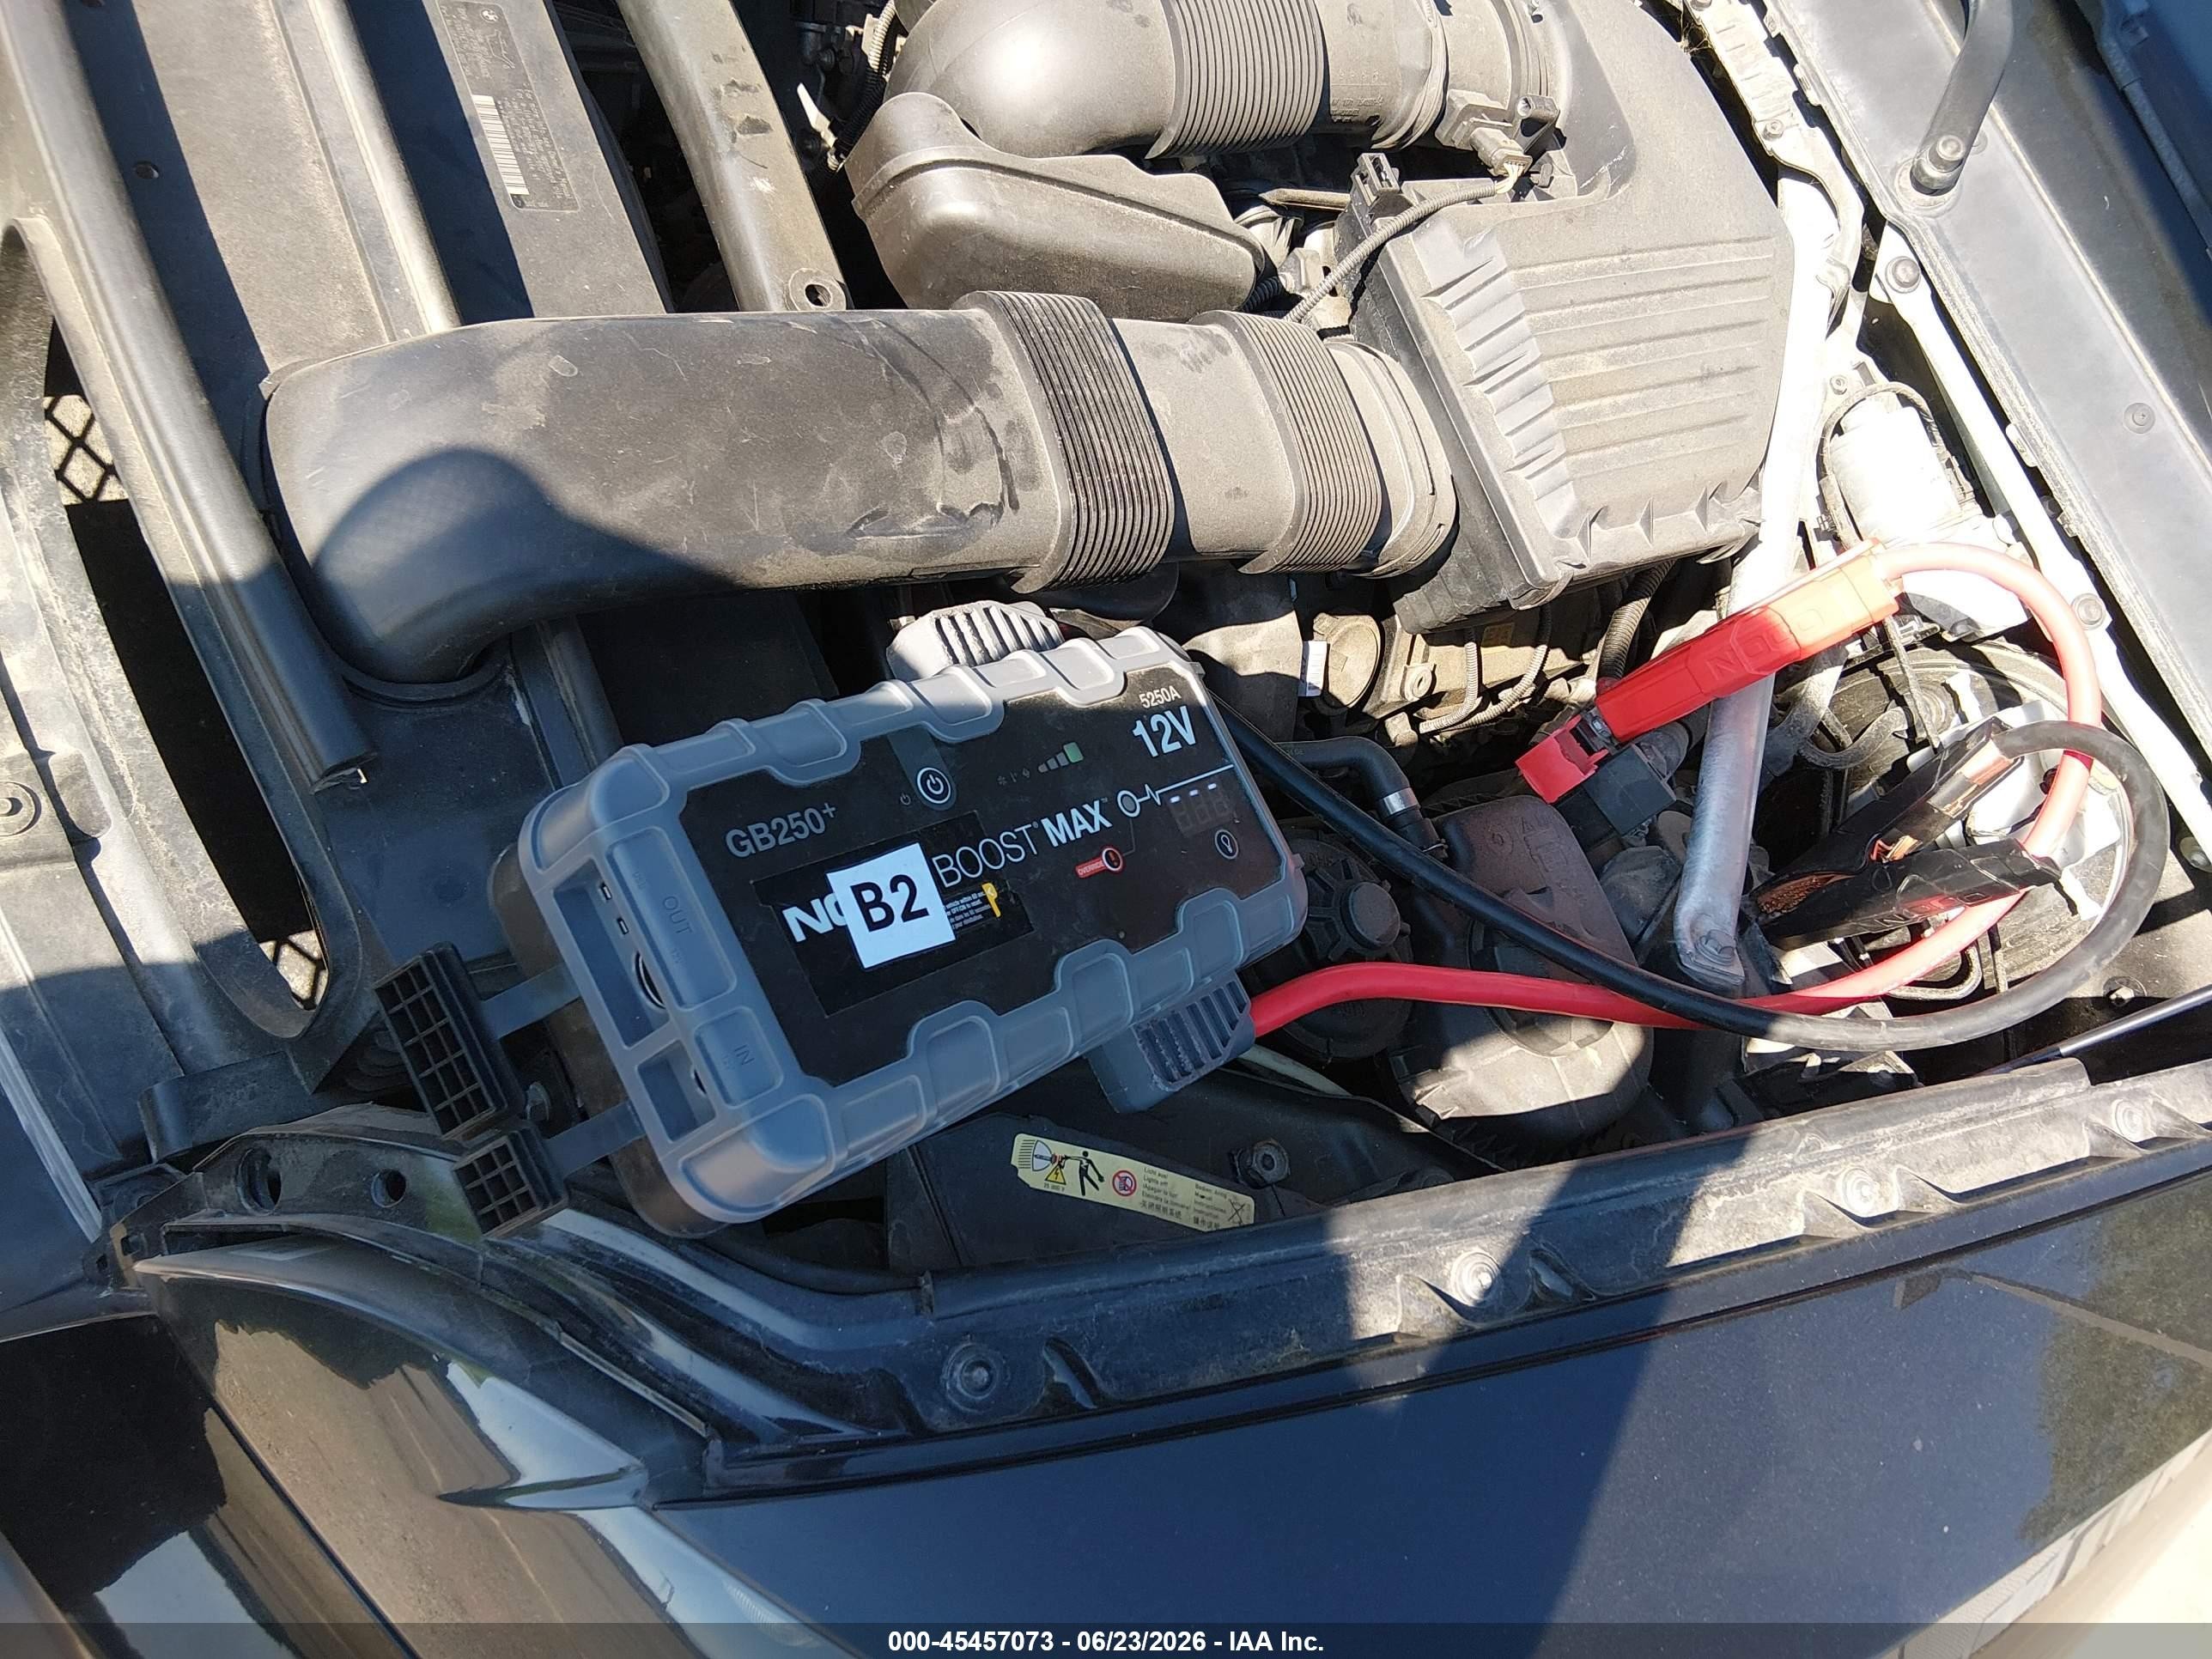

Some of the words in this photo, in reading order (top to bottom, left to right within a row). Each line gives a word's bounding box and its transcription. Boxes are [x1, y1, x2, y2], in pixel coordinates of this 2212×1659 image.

[1139, 685, 1182, 708] 5250A
[1133, 706, 1196, 757] 12V
[726, 803, 836, 857] GB250+
[663, 895, 693, 936] OUT
[850, 874, 930, 933] B2
[733, 1044, 756, 1066] IN
